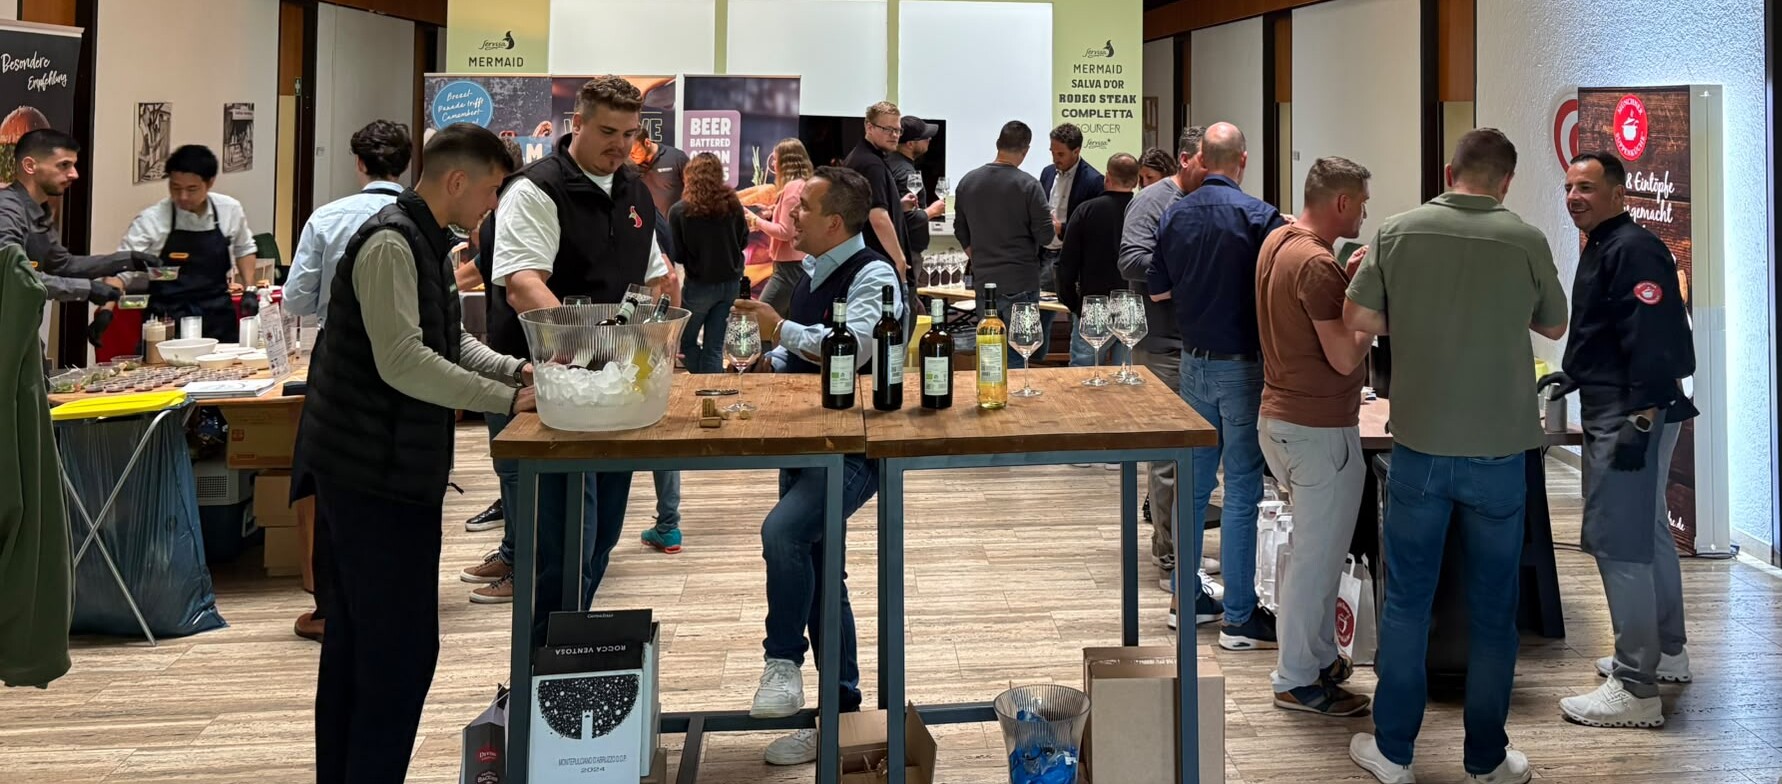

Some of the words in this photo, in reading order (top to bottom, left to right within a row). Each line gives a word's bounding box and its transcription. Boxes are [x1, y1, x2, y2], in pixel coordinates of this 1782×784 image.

[1, 50, 51, 74] Besondere
[468, 56, 524, 67] MERMAID
[1073, 64, 1123, 74] MERMAID
[27, 70, 68, 92] Empfehlung
[1071, 79, 1101, 89] SALVA
[1103, 80, 1125, 89] D'OR
[1059, 94, 1096, 103] RODEO
[1099, 95, 1137, 104] STEAK
[1061, 108, 1134, 119] COMPLETTA
[690, 117, 732, 136] BEER
[690, 138, 731, 148] BATTERED
[1625, 172, 1633, 190] &
[1634, 170, 1675, 204] Eintöpfe
[555, 647, 594, 656] VENTOSA
[596, 645, 626, 653] ROCCA
